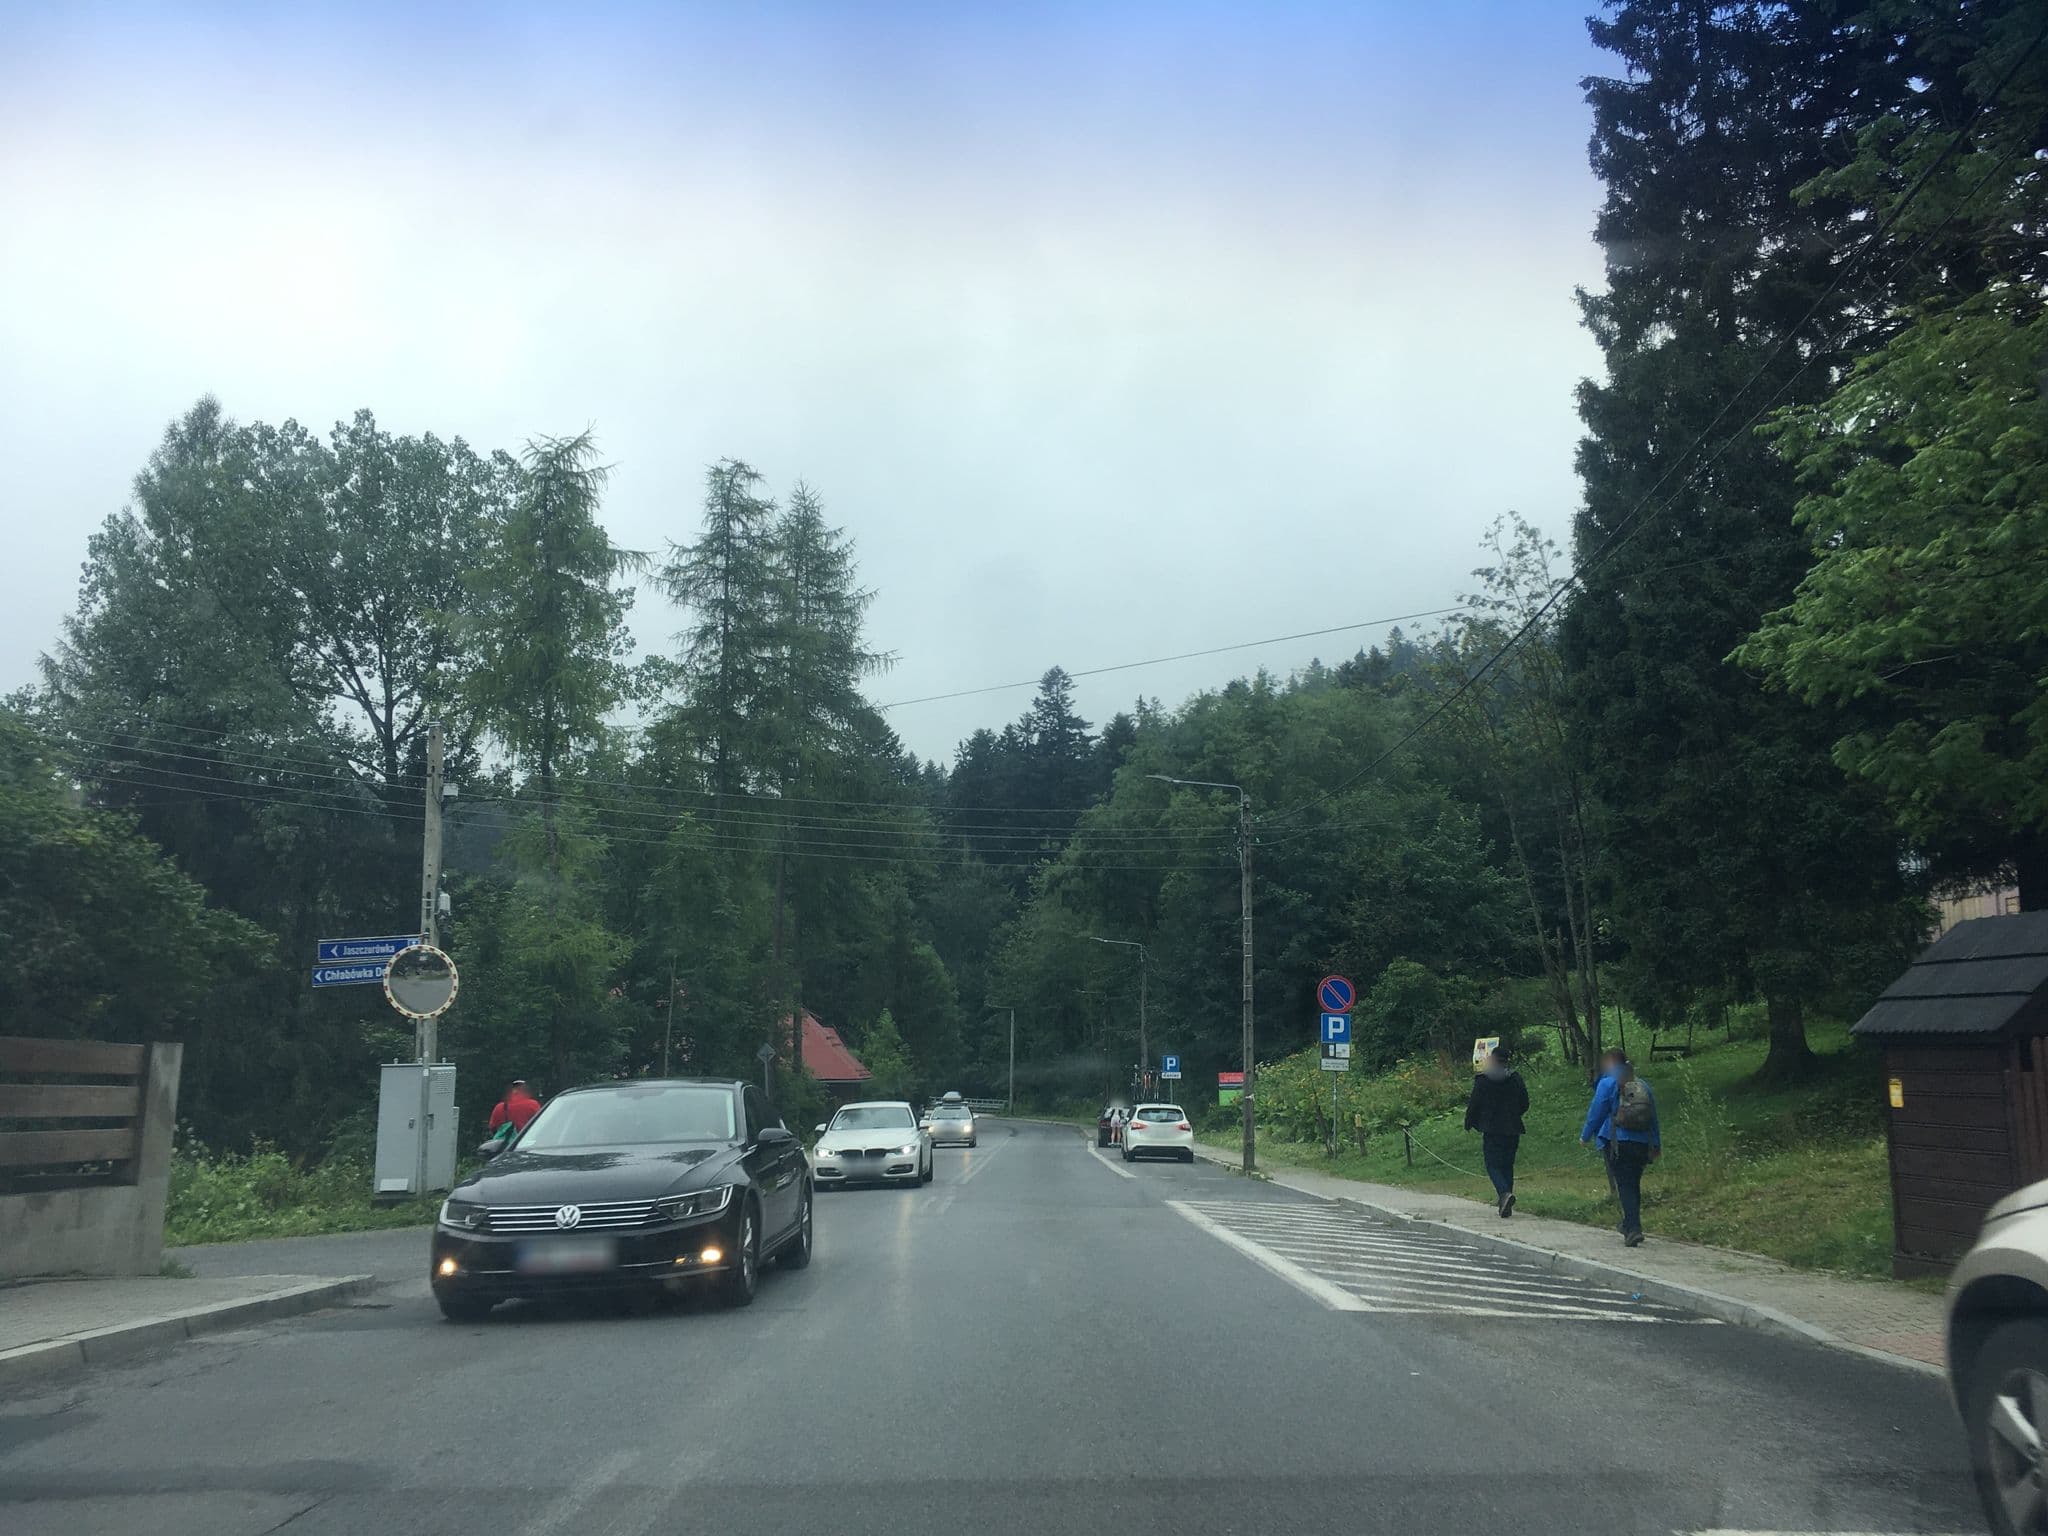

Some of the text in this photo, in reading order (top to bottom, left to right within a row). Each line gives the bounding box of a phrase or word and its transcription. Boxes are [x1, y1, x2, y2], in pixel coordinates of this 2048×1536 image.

[325, 968, 373, 981] Chłabówka
[1328, 1016, 1345, 1039] P
[1166, 1057, 1176, 1070] P
